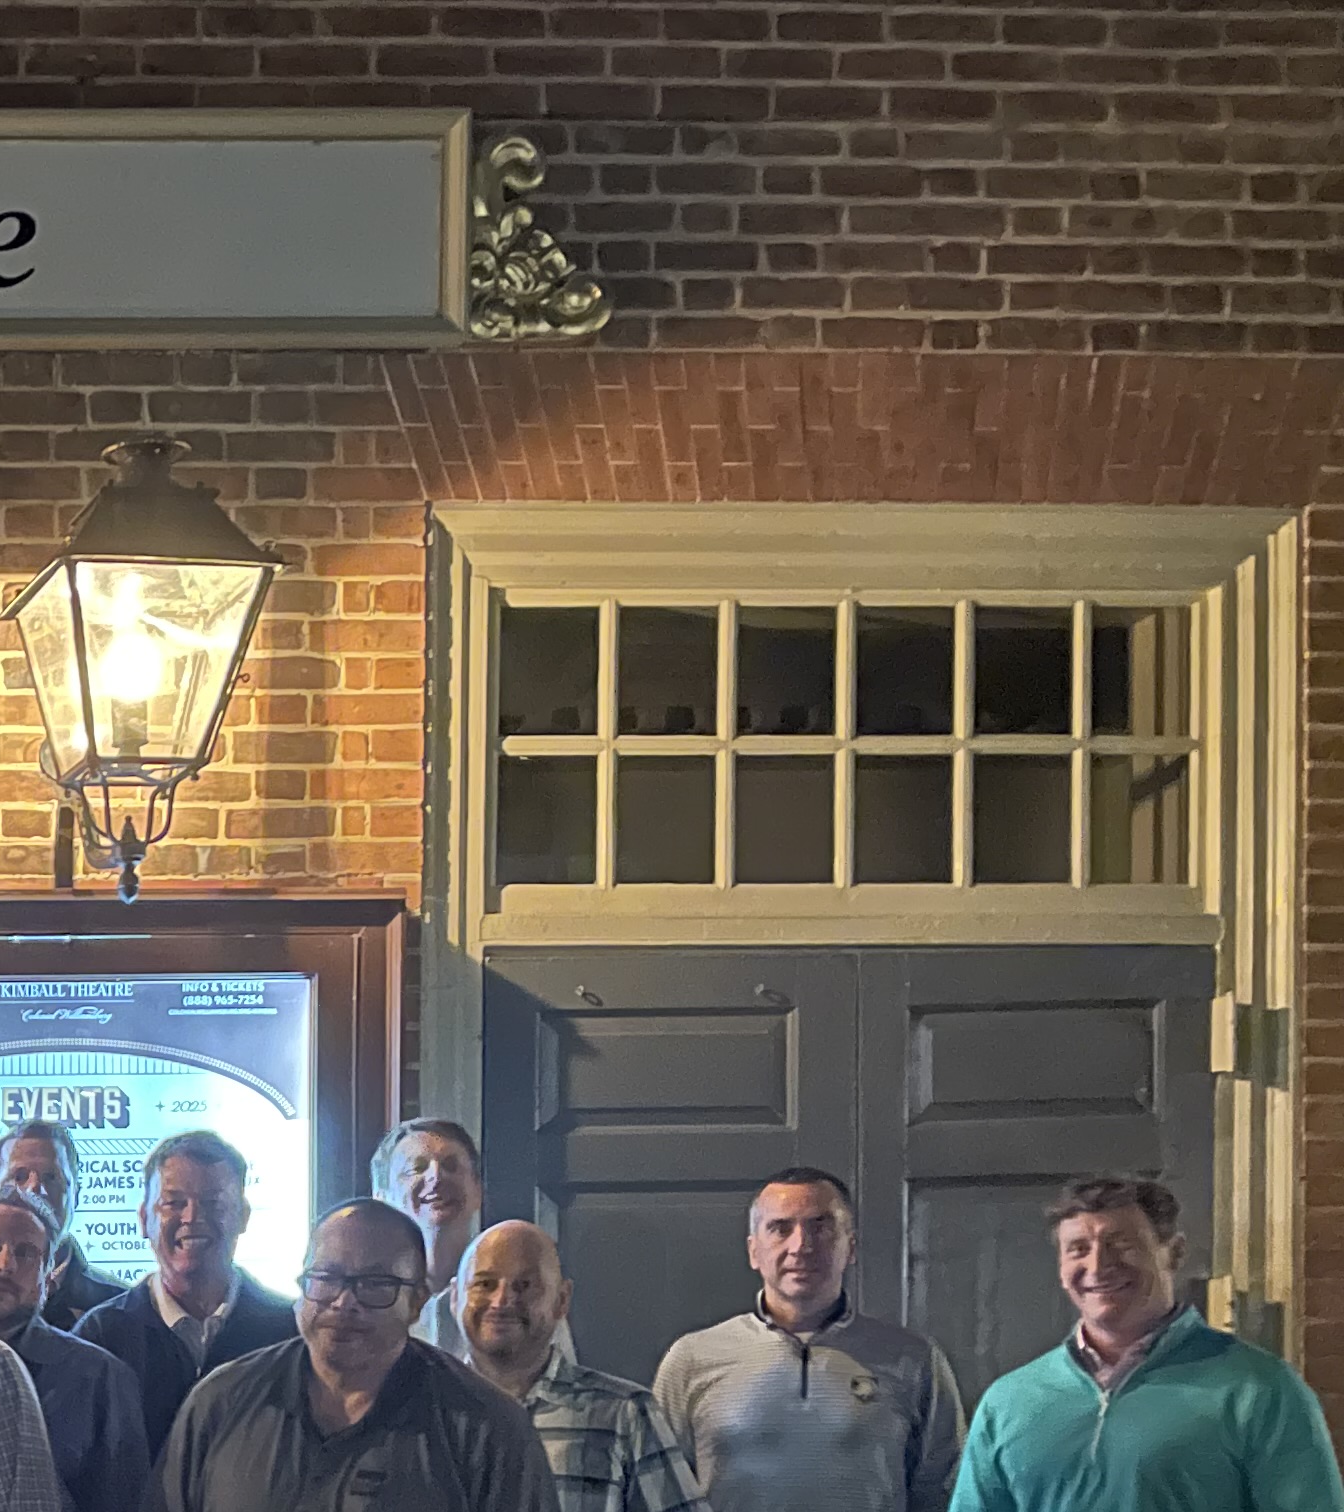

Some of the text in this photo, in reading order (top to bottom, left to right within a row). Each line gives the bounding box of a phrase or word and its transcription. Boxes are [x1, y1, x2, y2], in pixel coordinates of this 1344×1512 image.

[0, 982, 134, 998] KIMBALL THEATRE
[182, 982, 265, 992] INFO & TICKETS
[1, 1086, 127, 1126] EVENTS
[86, 1176, 135, 1189] JAMES
[108, 1195, 126, 1204] PM
[84, 1223, 137, 1235] YOUTH
